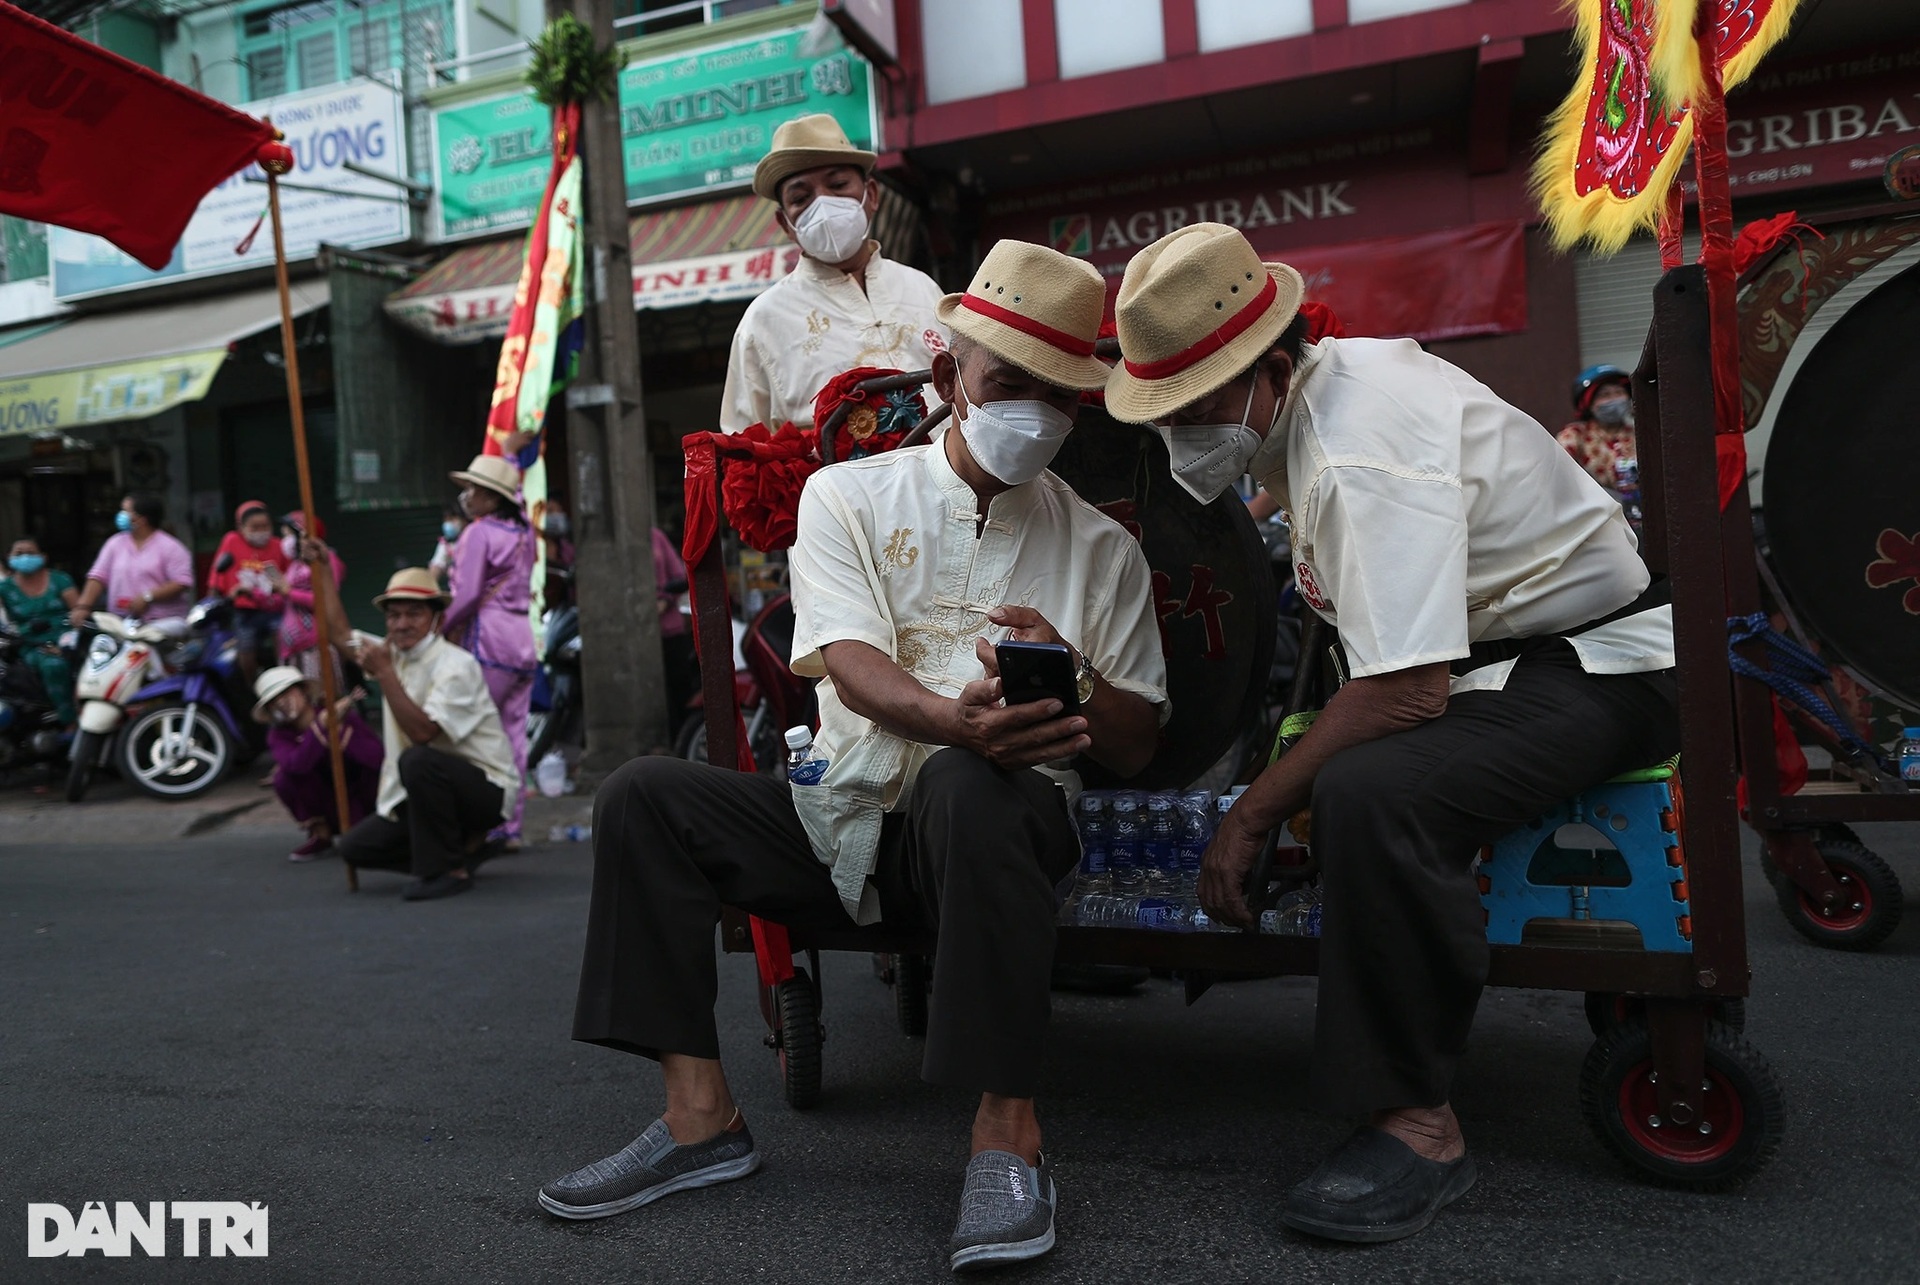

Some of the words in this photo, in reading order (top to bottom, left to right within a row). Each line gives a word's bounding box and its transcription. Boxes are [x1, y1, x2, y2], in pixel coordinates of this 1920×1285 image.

[620, 67, 807, 138] MINH
[1724, 92, 1920, 158] GRIBA
[291, 119, 386, 173] ƯƠNG
[468, 165, 549, 203] CHUYÊ
[1096, 180, 1356, 250] AGRIBANK
[632, 263, 736, 293] INH
[1008, 1165, 1025, 1202] FASHION
